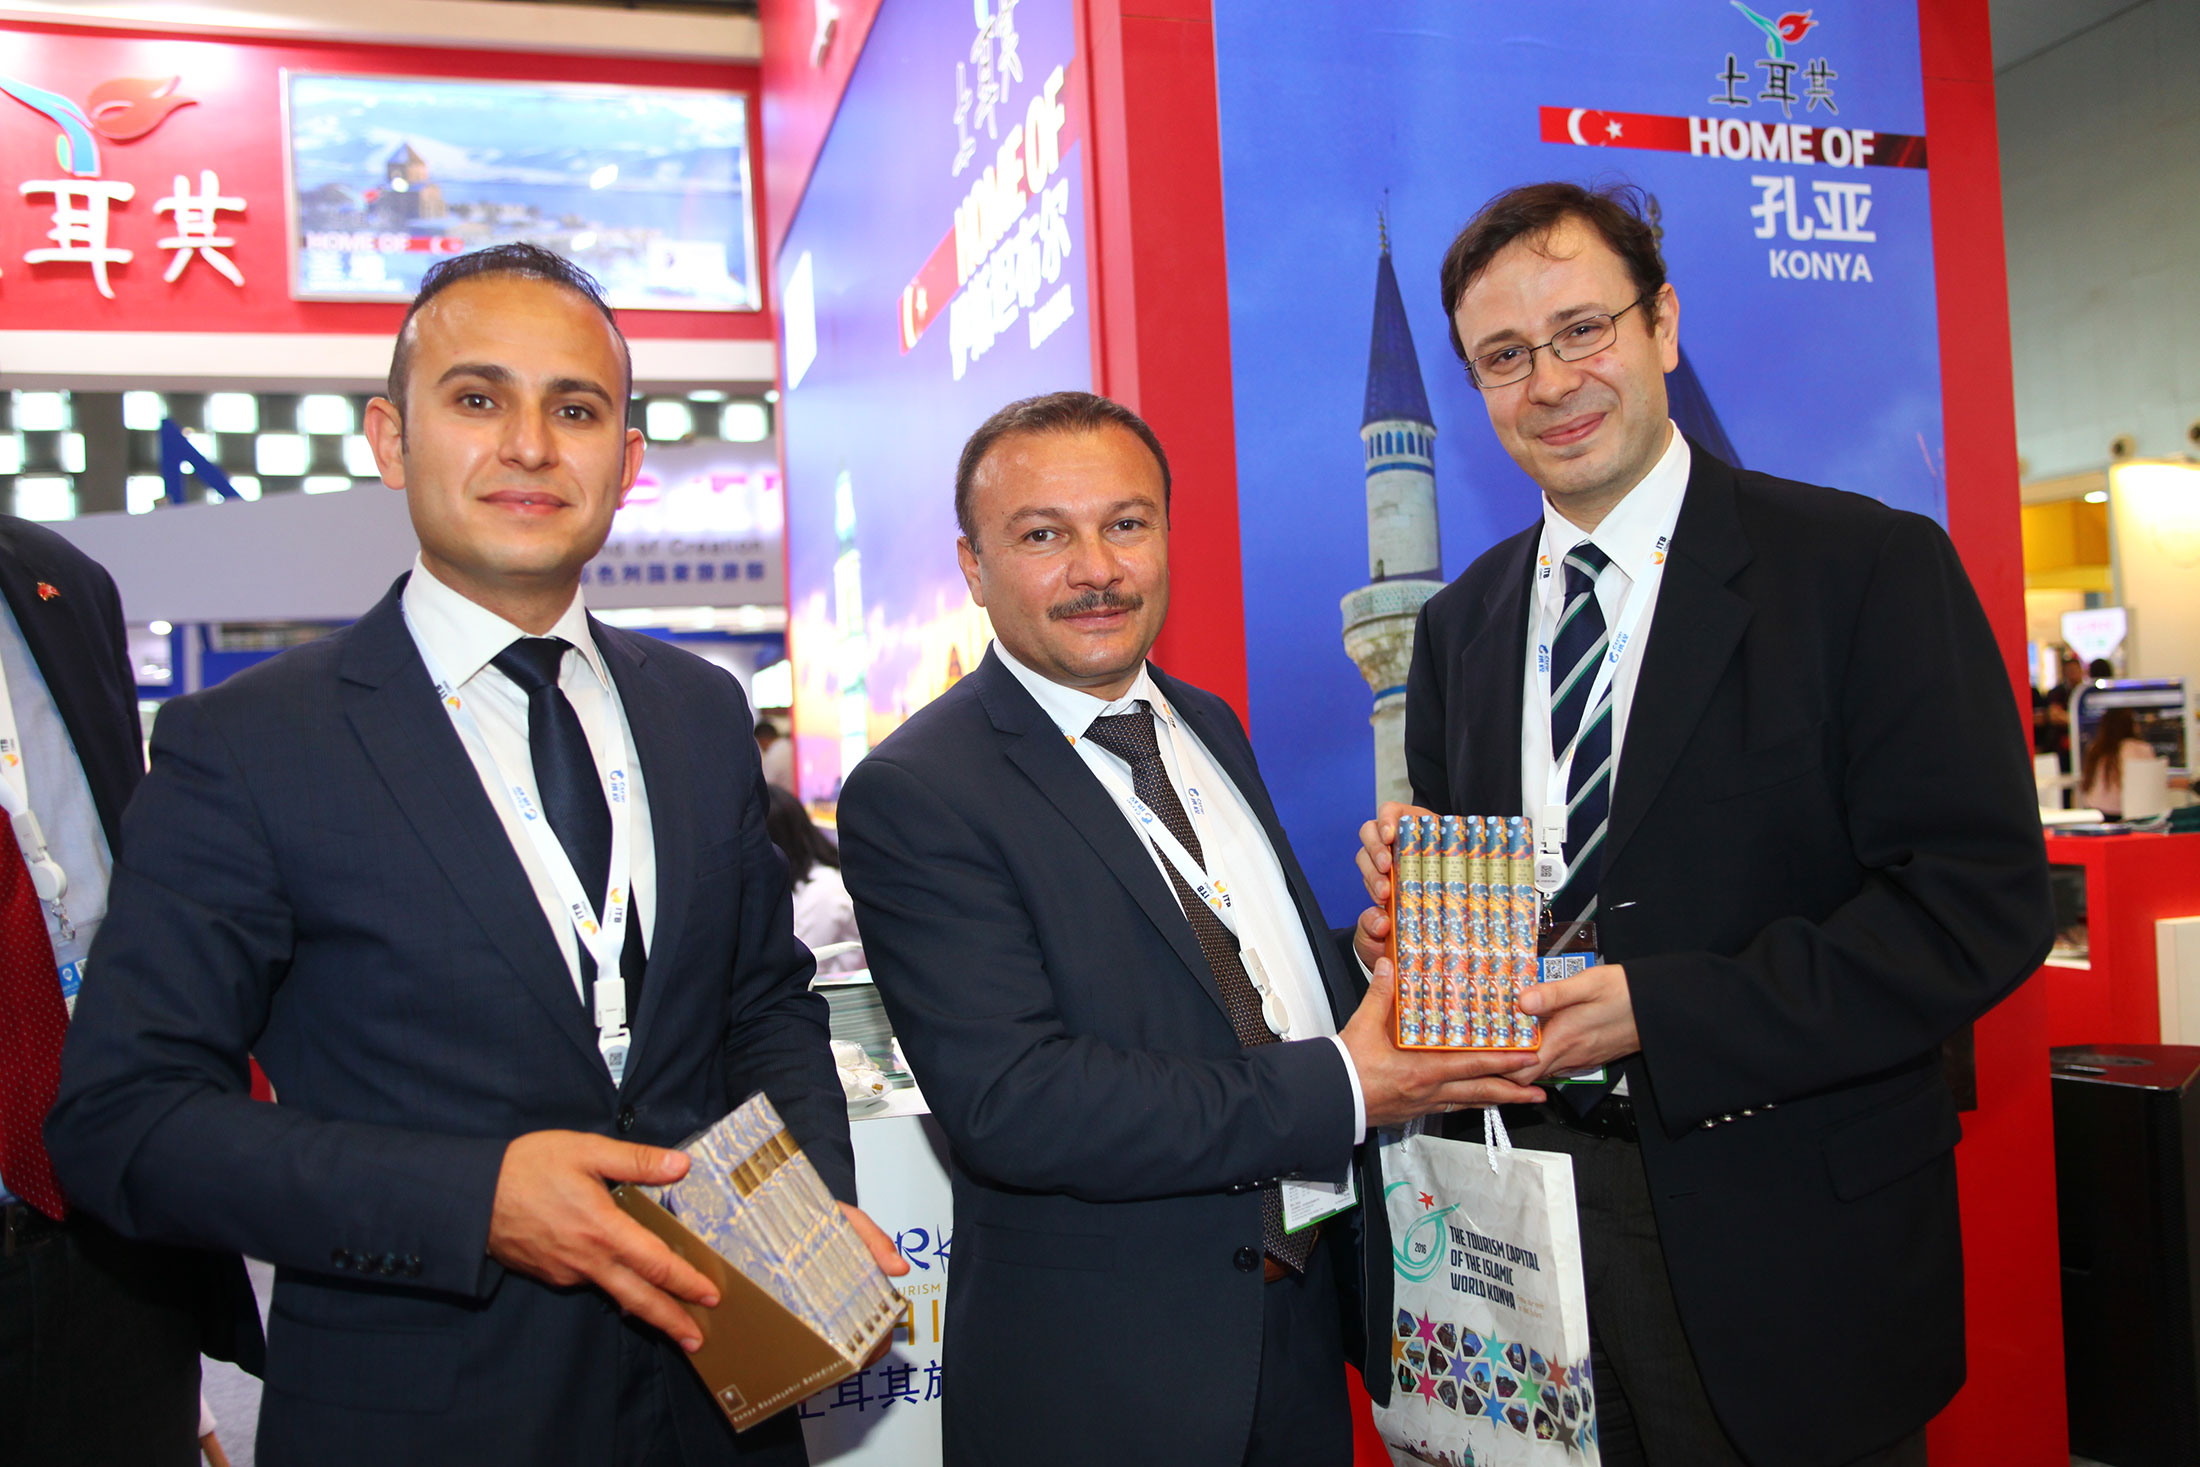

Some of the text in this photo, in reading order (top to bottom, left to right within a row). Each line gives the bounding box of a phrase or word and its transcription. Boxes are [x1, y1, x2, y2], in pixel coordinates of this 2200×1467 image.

[1025, 65, 1067, 194] OF
[1689, 115, 1875, 169] HOME OF
[1750, 175, 1877, 242] 孔亚
[0, 169, 248, 299] 耳其
[1768, 249, 1874, 282] KONYA
[1655, 535, 1668, 550] ITB
[1542, 567, 1551, 579] ITB
[1196, 885, 1210, 899] ITB
[571, 902, 585, 920] ITB
[613, 906, 623, 923] ITB
[1414, 1242, 1427, 1255] 2016
[1449, 1225, 1541, 1272] THE TOURISM CAPITAL
[1450, 1249, 1514, 1287] OF THE ISLAMIC
[899, 1283, 942, 1297] URISM
[1450, 1272, 1487, 1299] WORLD
[1486, 1282, 1516, 1311] KONYA
